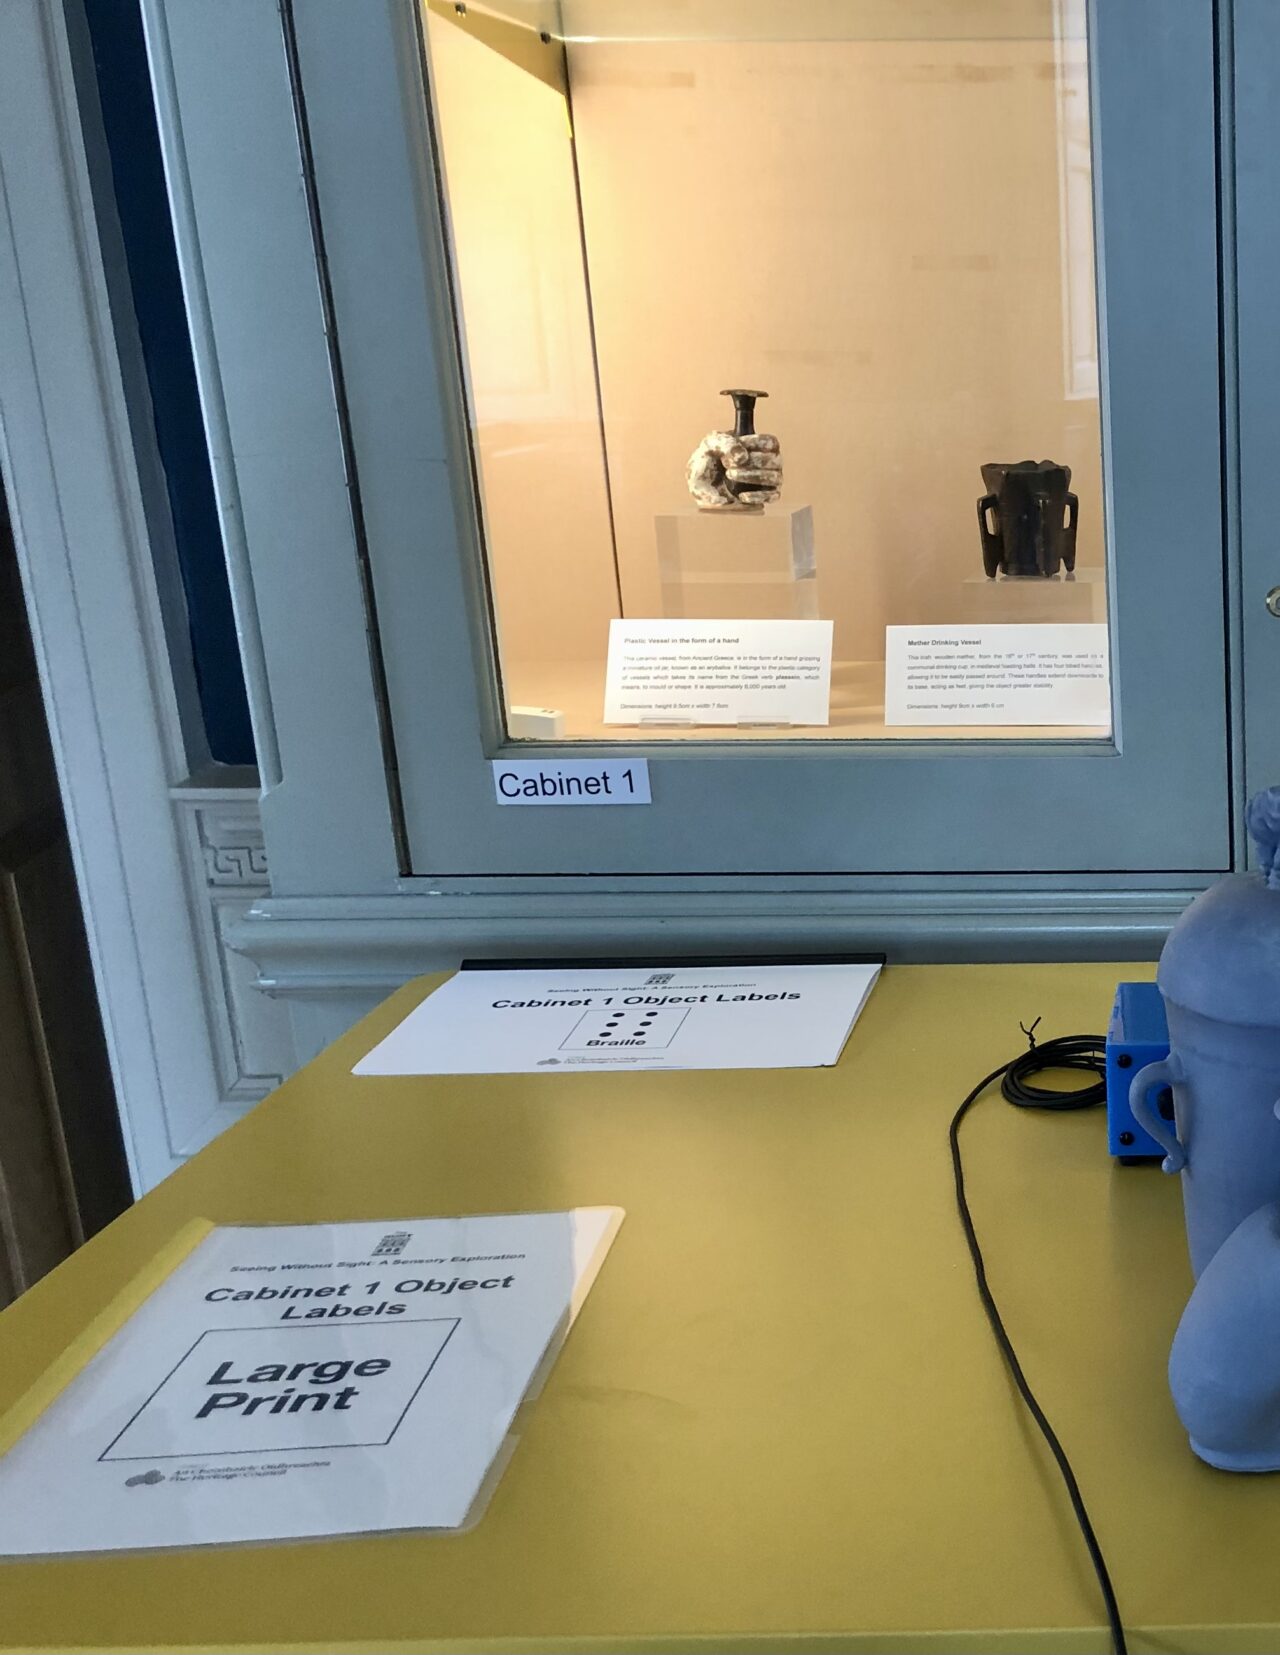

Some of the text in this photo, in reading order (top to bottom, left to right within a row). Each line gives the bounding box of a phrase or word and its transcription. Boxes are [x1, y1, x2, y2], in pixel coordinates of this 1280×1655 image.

[499, 769, 634, 797] Cabinet 1
[492, 991, 801, 1009] Cabinet 1 Object Labels
[586, 1039, 646, 1047] Braille
[230, 1265, 278, 1273] Seeing
[281, 1262, 334, 1271] Without
[392, 1257, 449, 1266] Sensory
[450, 1253, 526, 1264] Exploration
[205, 1275, 516, 1302] Cabinet 1 Object
[280, 1302, 407, 1320] Labels
[205, 1358, 391, 1386] Large
[194, 1386, 360, 1419] Print
